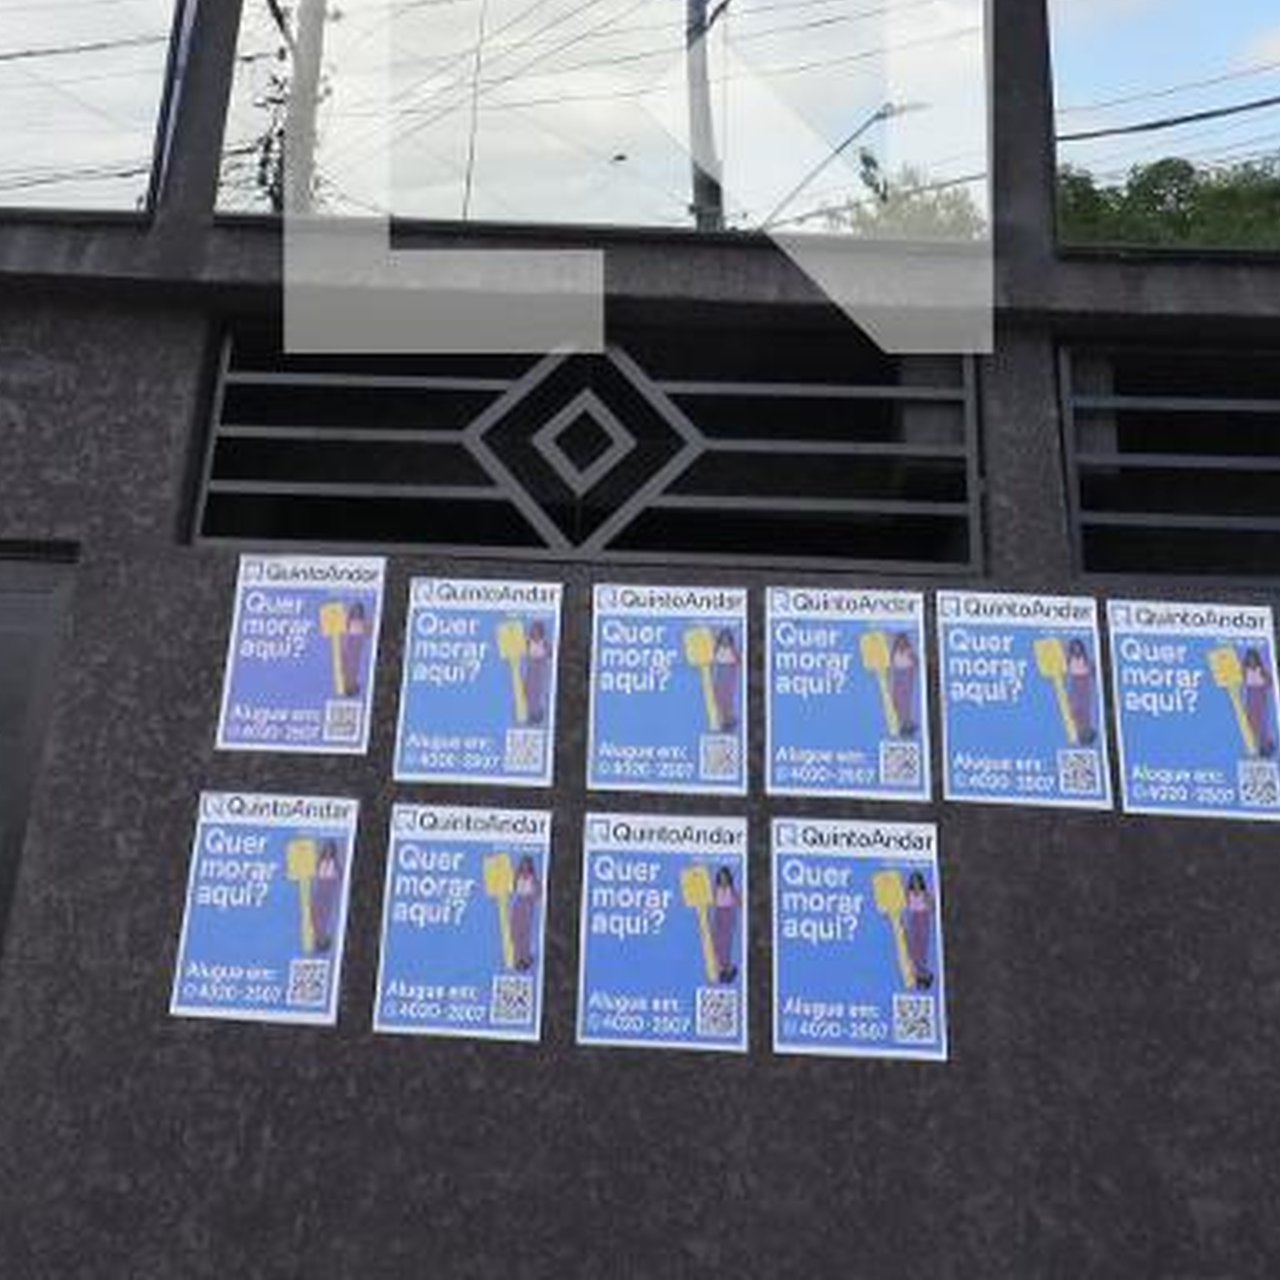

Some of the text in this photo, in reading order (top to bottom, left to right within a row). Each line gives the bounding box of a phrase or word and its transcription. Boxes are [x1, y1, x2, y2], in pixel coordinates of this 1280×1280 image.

[245, 592, 302, 613] Quer
[792, 592, 916, 612] QuintoAndar
[965, 597, 1093, 620] QuintoAndar
[242, 618, 313, 635] morar
[418, 613, 479, 633] Quer
[1136, 608, 1266, 630] QuintoAndar
[602, 622, 665, 643] Quer
[775, 623, 839, 645] Quer
[949, 628, 1014, 652] Quer
[239, 638, 305, 661] aqui?
[414, 639, 488, 657] morar
[601, 649, 676, 667] morar
[1121, 638, 1187, 663] Quer
[775, 651, 852, 669] morar
[949, 656, 1027, 677] morar
[413, 661, 480, 685] aqui?
[600, 669, 669, 694] aqui?
[1122, 667, 1202, 688] morar
[776, 672, 845, 698] aqui?
[950, 679, 1023, 706] aqui?
[1126, 689, 1198, 716] aqui?
[227, 796, 351, 819] QuintoAndar
[419, 812, 548, 835] QuintoAndar
[613, 821, 743, 845] QuintoAndar
[205, 828, 267, 853] Quer
[802, 826, 933, 850] QuintoAndar
[398, 844, 463, 870] Quer
[594, 856, 661, 881] Quer
[201, 858, 279, 880] morar
[783, 860, 850, 887] Quer
[197, 881, 268, 908] aqui?
[395, 873, 474, 897] morar
[593, 886, 674, 908] morar
[782, 891, 863, 914] morar
[393, 897, 466, 926] aqui?
[592, 909, 665, 938] aqui?
[783, 915, 858, 945] aqui?
